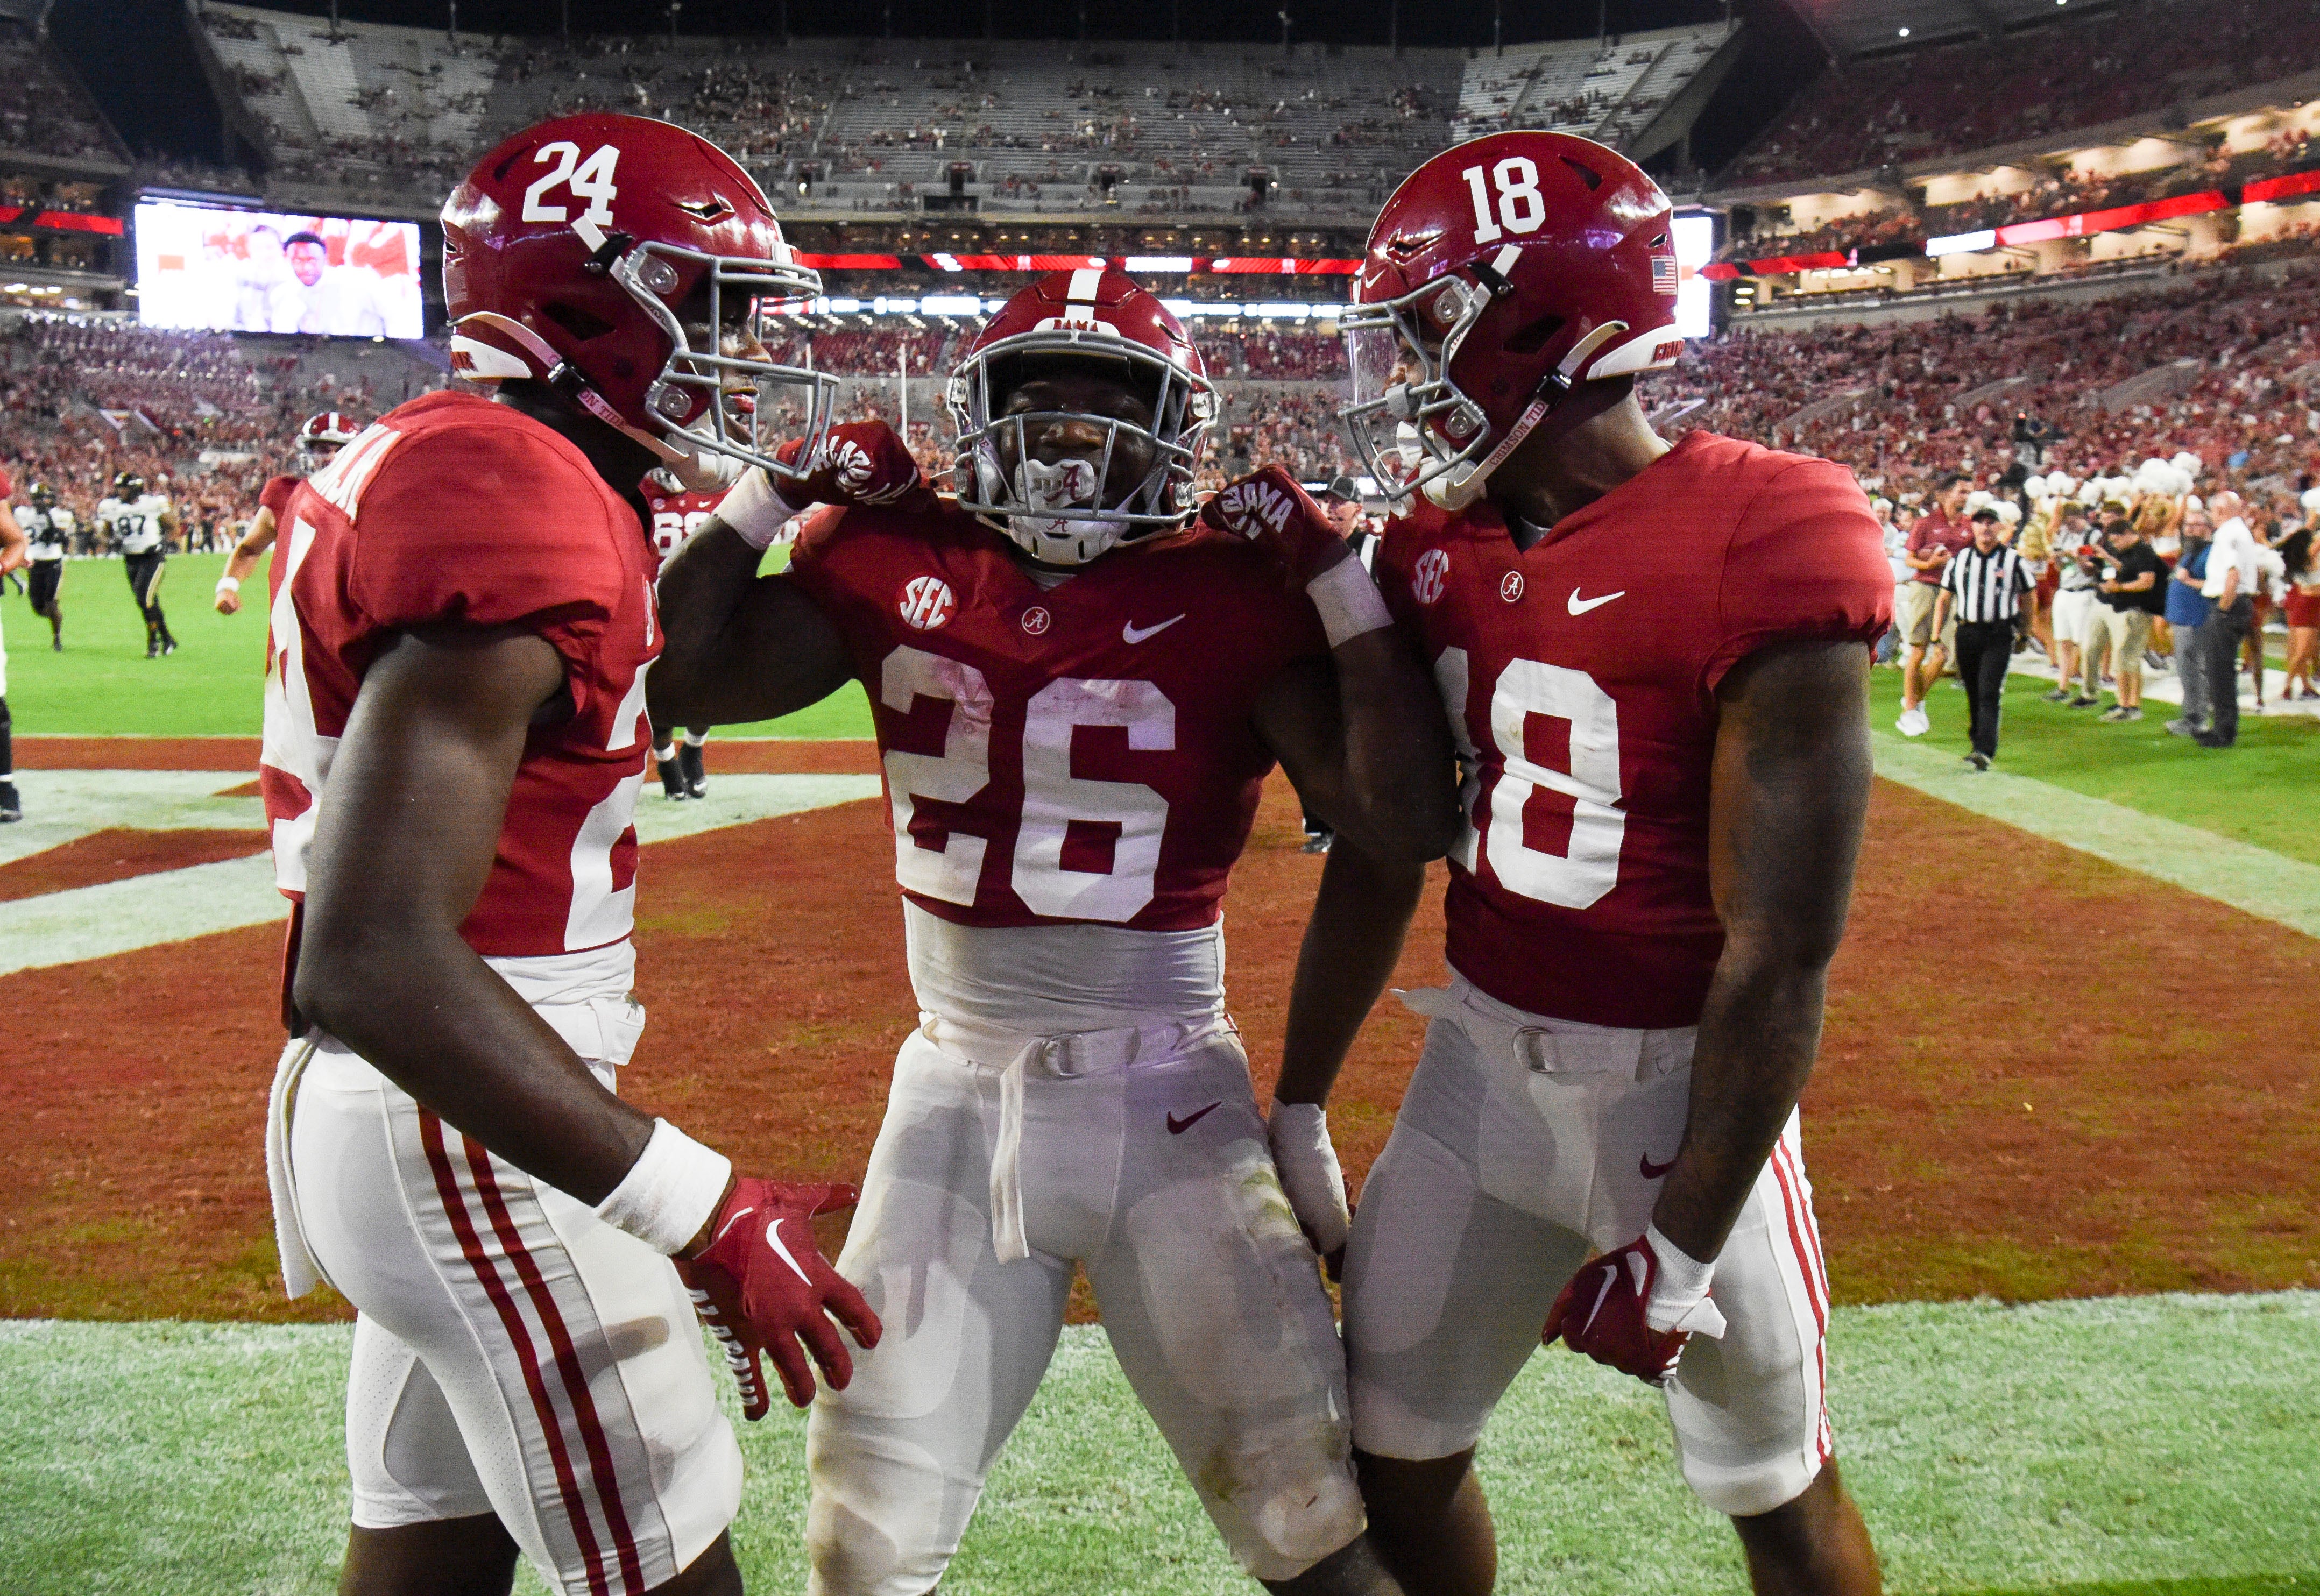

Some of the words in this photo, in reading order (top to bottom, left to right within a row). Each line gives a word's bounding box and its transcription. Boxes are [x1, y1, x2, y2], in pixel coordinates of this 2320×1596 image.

[523, 141, 620, 226] 24
[1462, 157, 1546, 245] 18
[1053, 318, 1099, 333] BAMA
[1489, 421, 1530, 466] CRIMSON
[1525, 401, 1546, 422] TID
[900, 576, 953, 630] SEC
[1411, 549, 1449, 604] SEC
[880, 643, 1176, 923] 26
